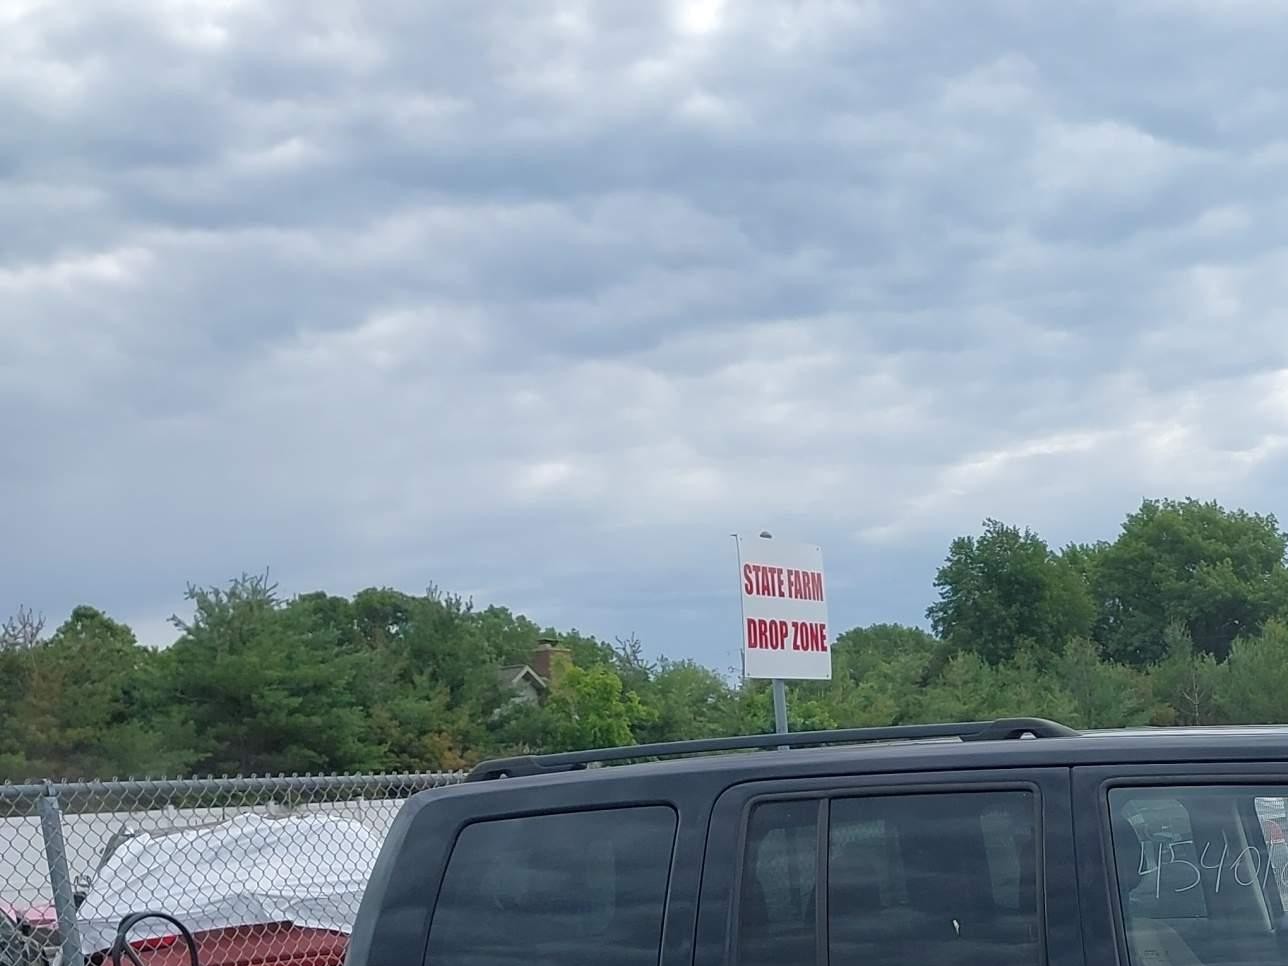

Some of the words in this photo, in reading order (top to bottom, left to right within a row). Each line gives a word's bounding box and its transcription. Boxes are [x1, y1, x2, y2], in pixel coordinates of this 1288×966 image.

[743, 563, 785, 598] STATE
[787, 568, 824, 602] FARM
[747, 617, 789, 651] DROP
[792, 621, 828, 652] ZONE
